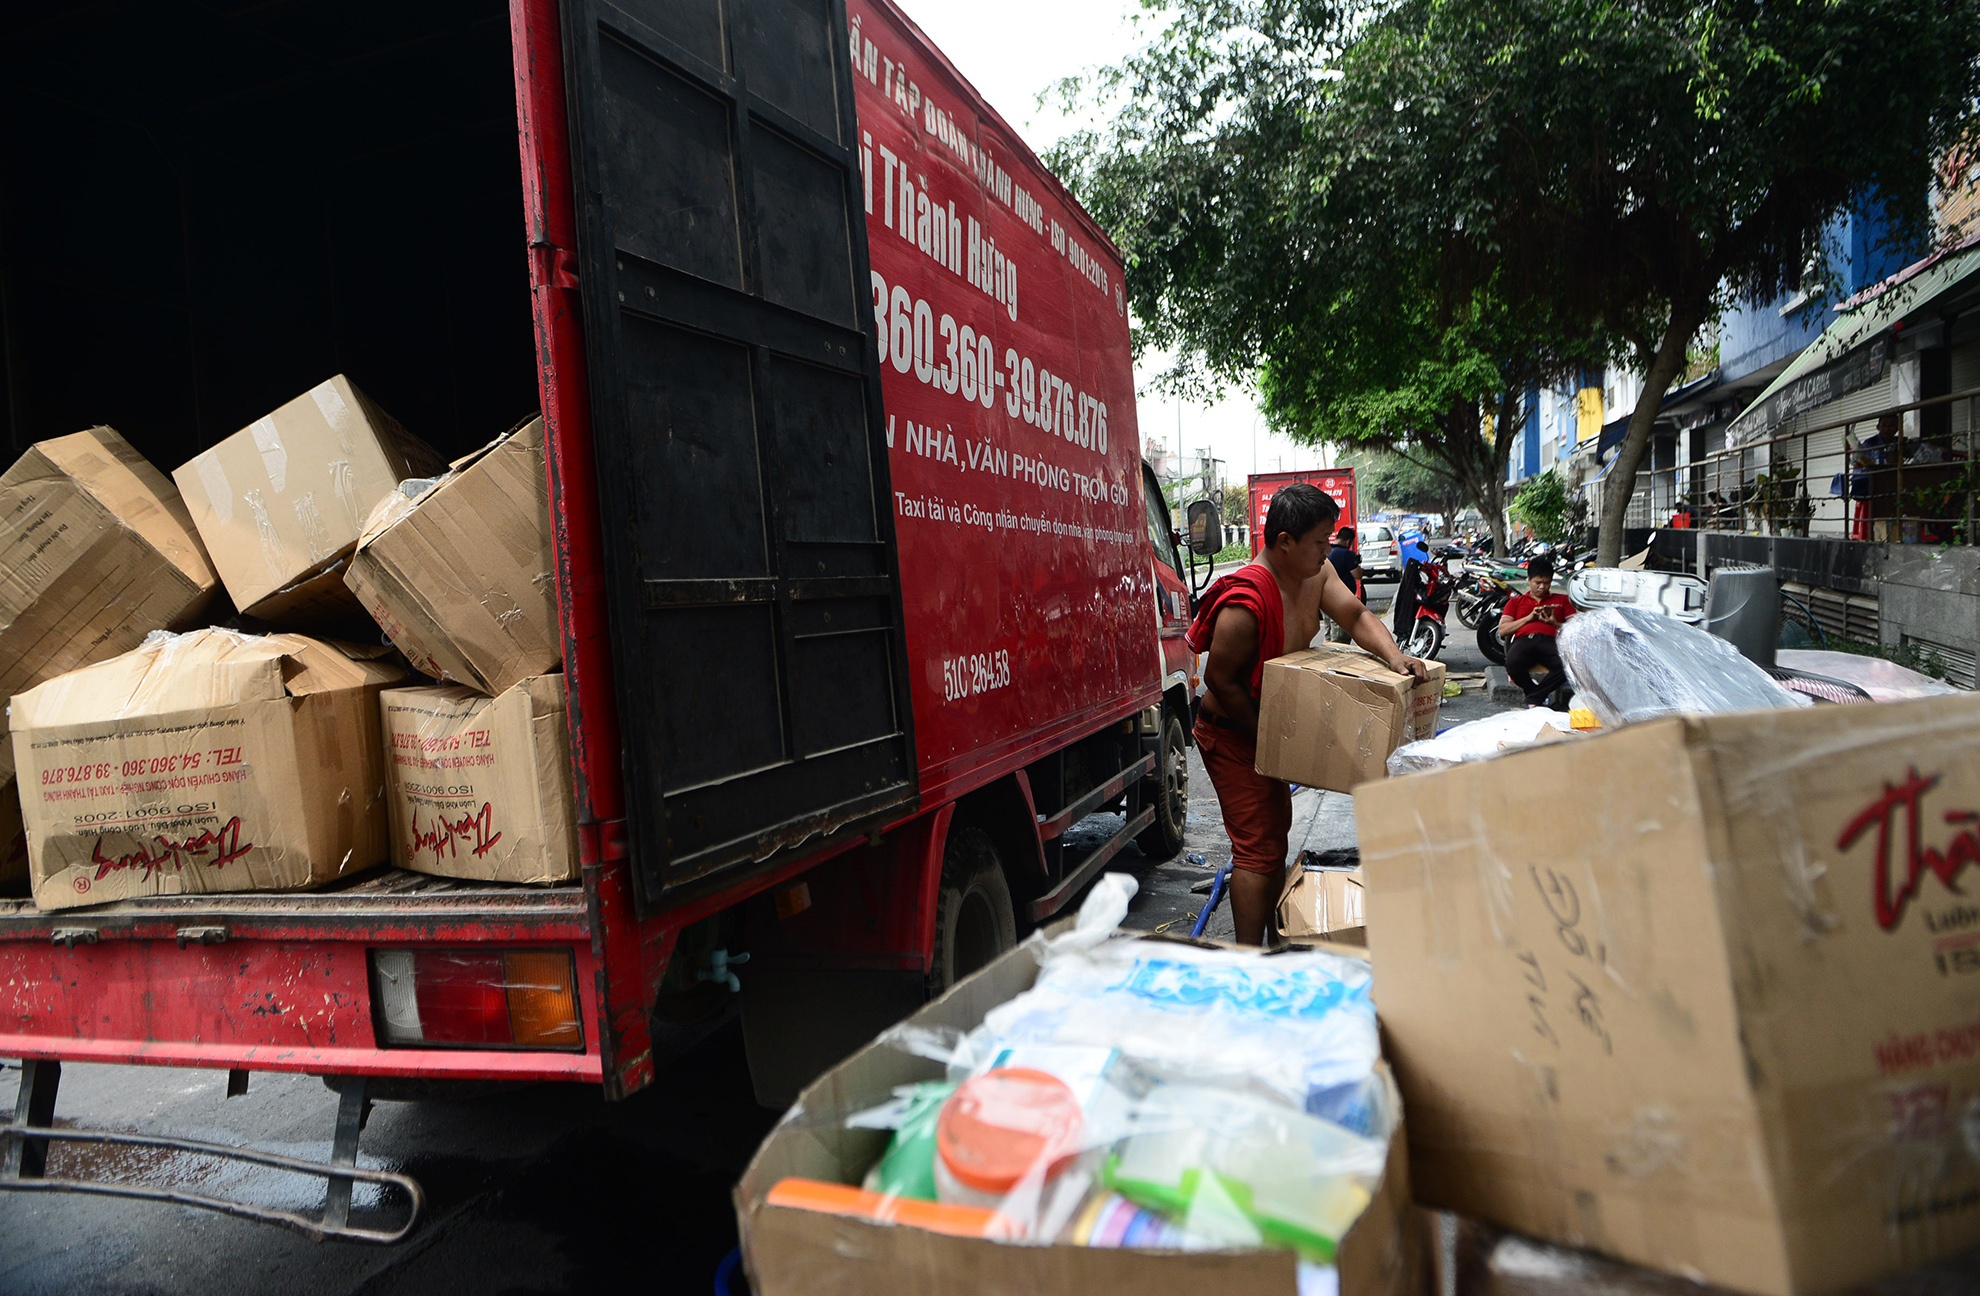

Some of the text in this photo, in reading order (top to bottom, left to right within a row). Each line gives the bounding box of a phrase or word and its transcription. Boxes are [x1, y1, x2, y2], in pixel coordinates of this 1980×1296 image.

[883, 55, 921, 119] TẬP
[924, 96, 969, 166] ĐOÀN
[969, 142, 1012, 208] THÀNH
[1050, 218, 1066, 257] ISO
[1068, 236, 1109, 296] 9001:2015
[879, 143, 962, 277] Thành
[967, 214, 1018, 322] Hưng
[1013, 453, 1070, 493] PHÒNG
[1073, 473, 1108, 505] TRỌN
[895, 491, 925, 518] Taxi
[928, 496, 945, 521] tải
[947, 500, 961, 523] và
[963, 503, 993, 532] Công
[995, 509, 1018, 530] nhân
[1020, 510, 1052, 536] chuyển
[1053, 517, 1068, 539] dọn
[943, 656, 968, 702] 51C
[464, 730, 491, 748] TEL:
[121, 752, 202, 777] 54.360.360
[206, 747, 242, 766] TEL:
[41, 763, 111, 786] 39.876.876
[448, 785, 474, 795] ISO
[74, 801, 216, 824] ISO 9001:2008
